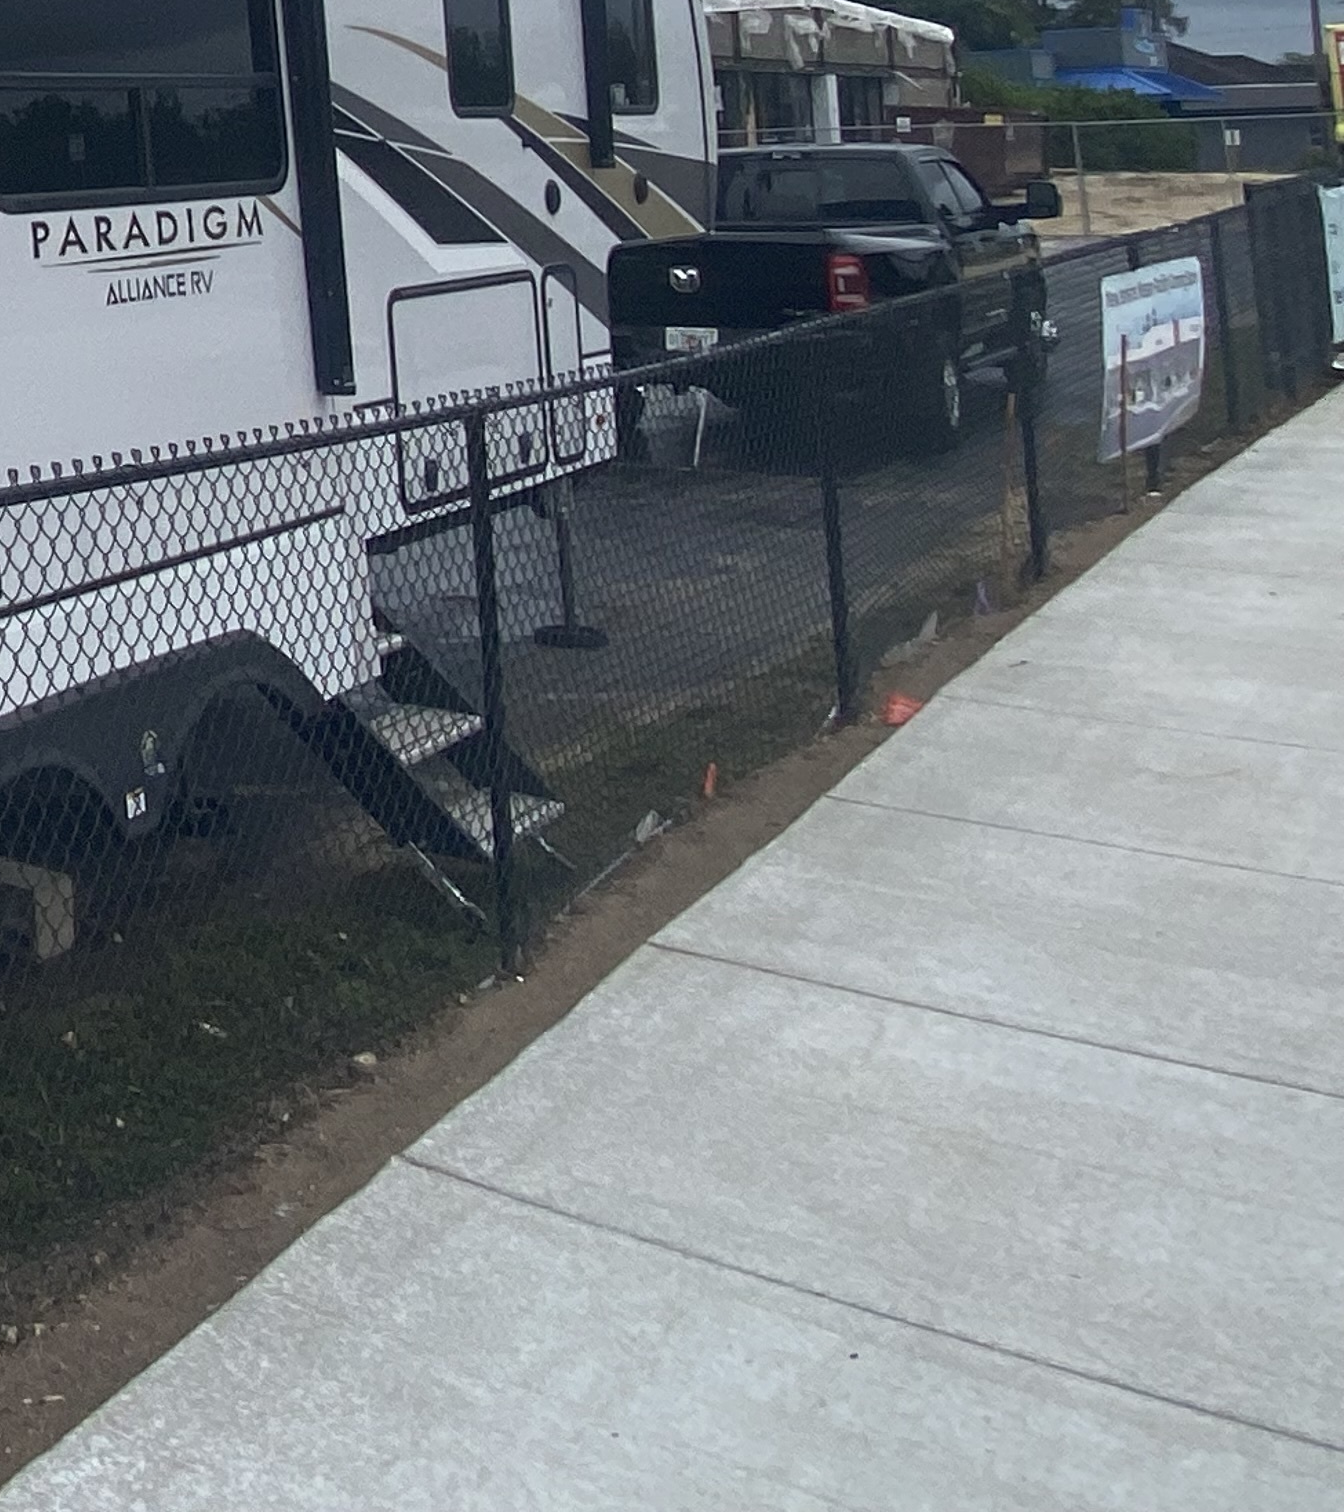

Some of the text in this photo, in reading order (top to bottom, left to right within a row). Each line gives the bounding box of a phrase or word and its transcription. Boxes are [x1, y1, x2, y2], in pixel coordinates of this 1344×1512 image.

[30, 199, 264, 259] PARADIGM
[106, 270, 214, 306] ALLIANCE RV
